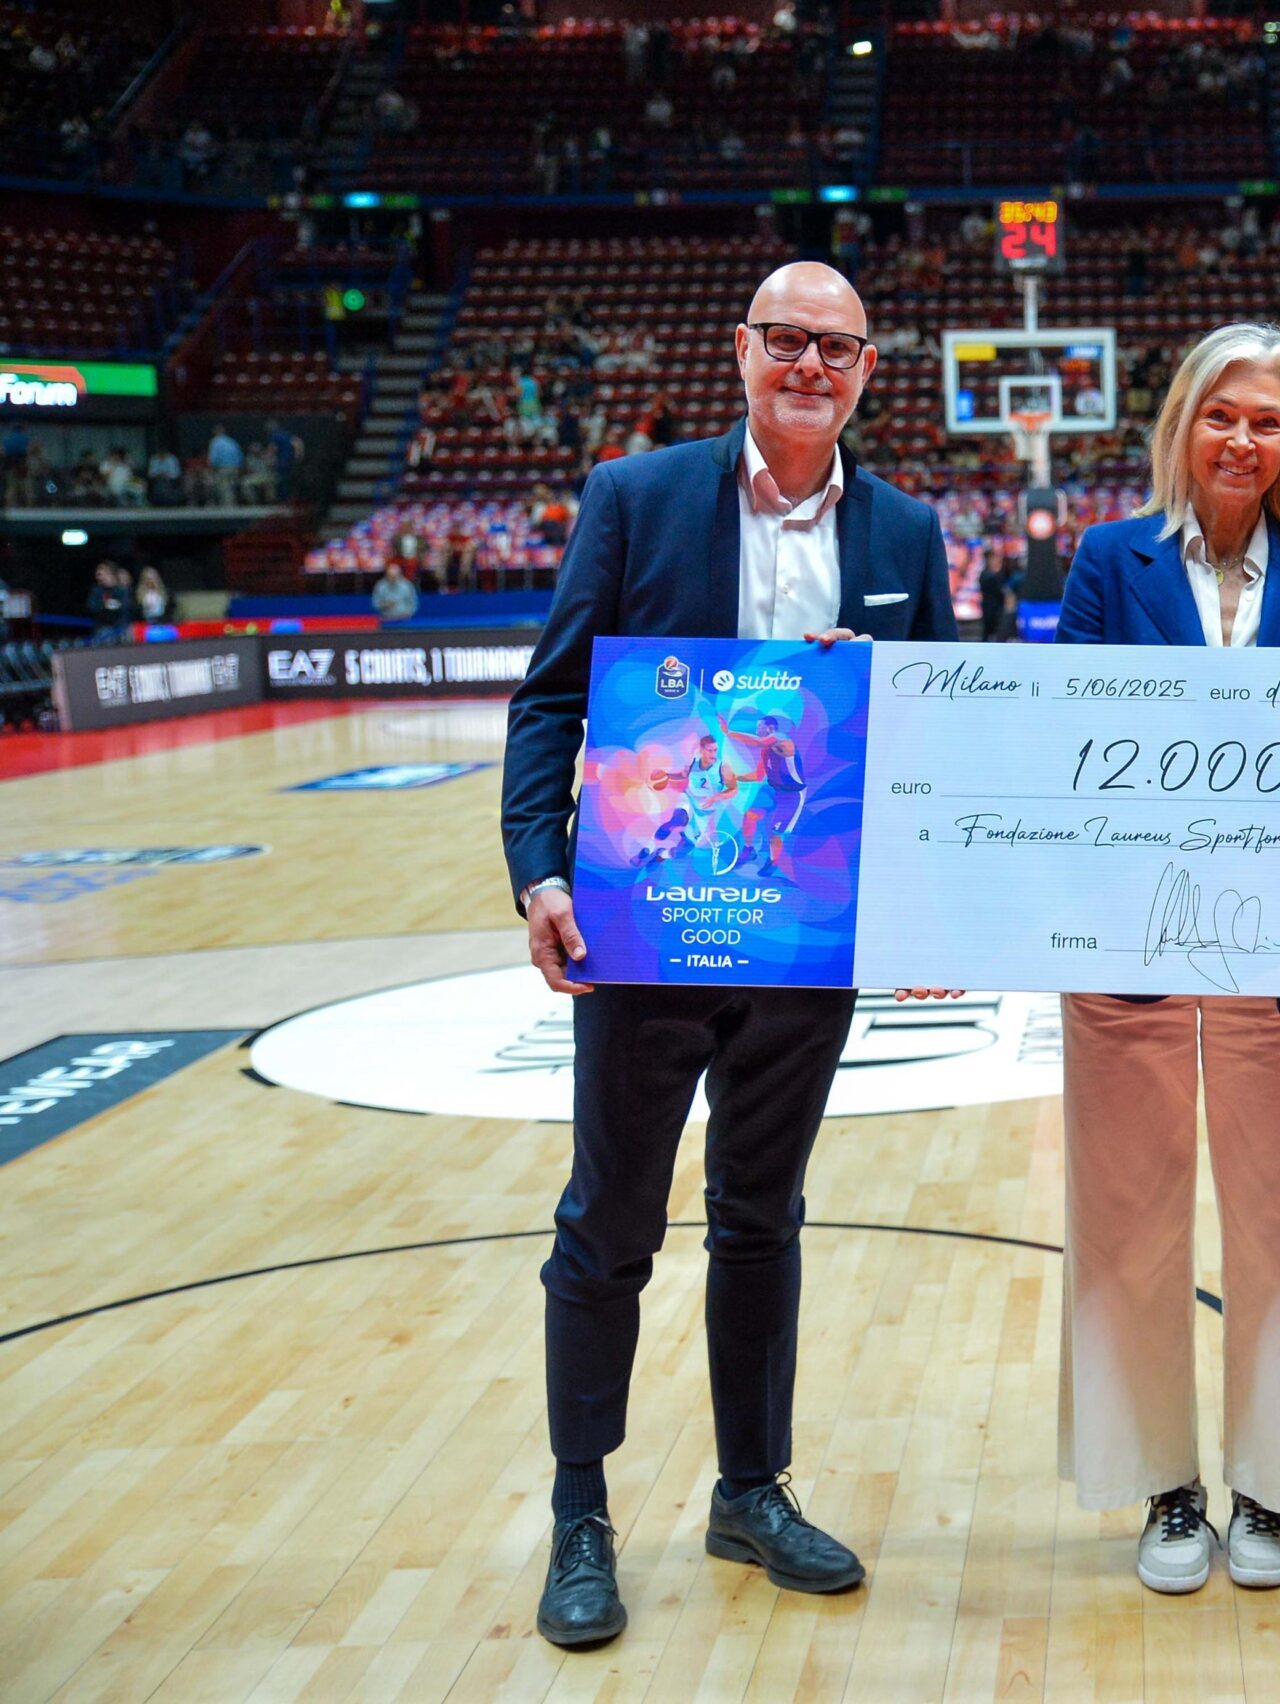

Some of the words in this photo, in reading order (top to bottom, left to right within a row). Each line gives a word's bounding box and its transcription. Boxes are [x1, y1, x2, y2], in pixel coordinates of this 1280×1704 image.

[1001, 222, 1057, 259] 24
[268, 649, 335, 680] EA7
[661, 679, 685, 689] LBA
[736, 671, 803, 691] subito
[892, 660, 1022, 700] Milano
[1065, 678, 1187, 698] 5/06/2025
[1210, 686, 1251, 700] euro
[891, 780, 932, 795] euro
[919, 827, 930, 842] a
[954, 813, 1081, 848] Fondazione
[1083, 816, 1172, 848] Laureus
[661, 907, 723, 924] SPORT
[727, 908, 764, 924] FOR
[681, 928, 741, 945] GOOD
[1050, 932, 1098, 950] firma
[687, 954, 733, 968] ITALIA
